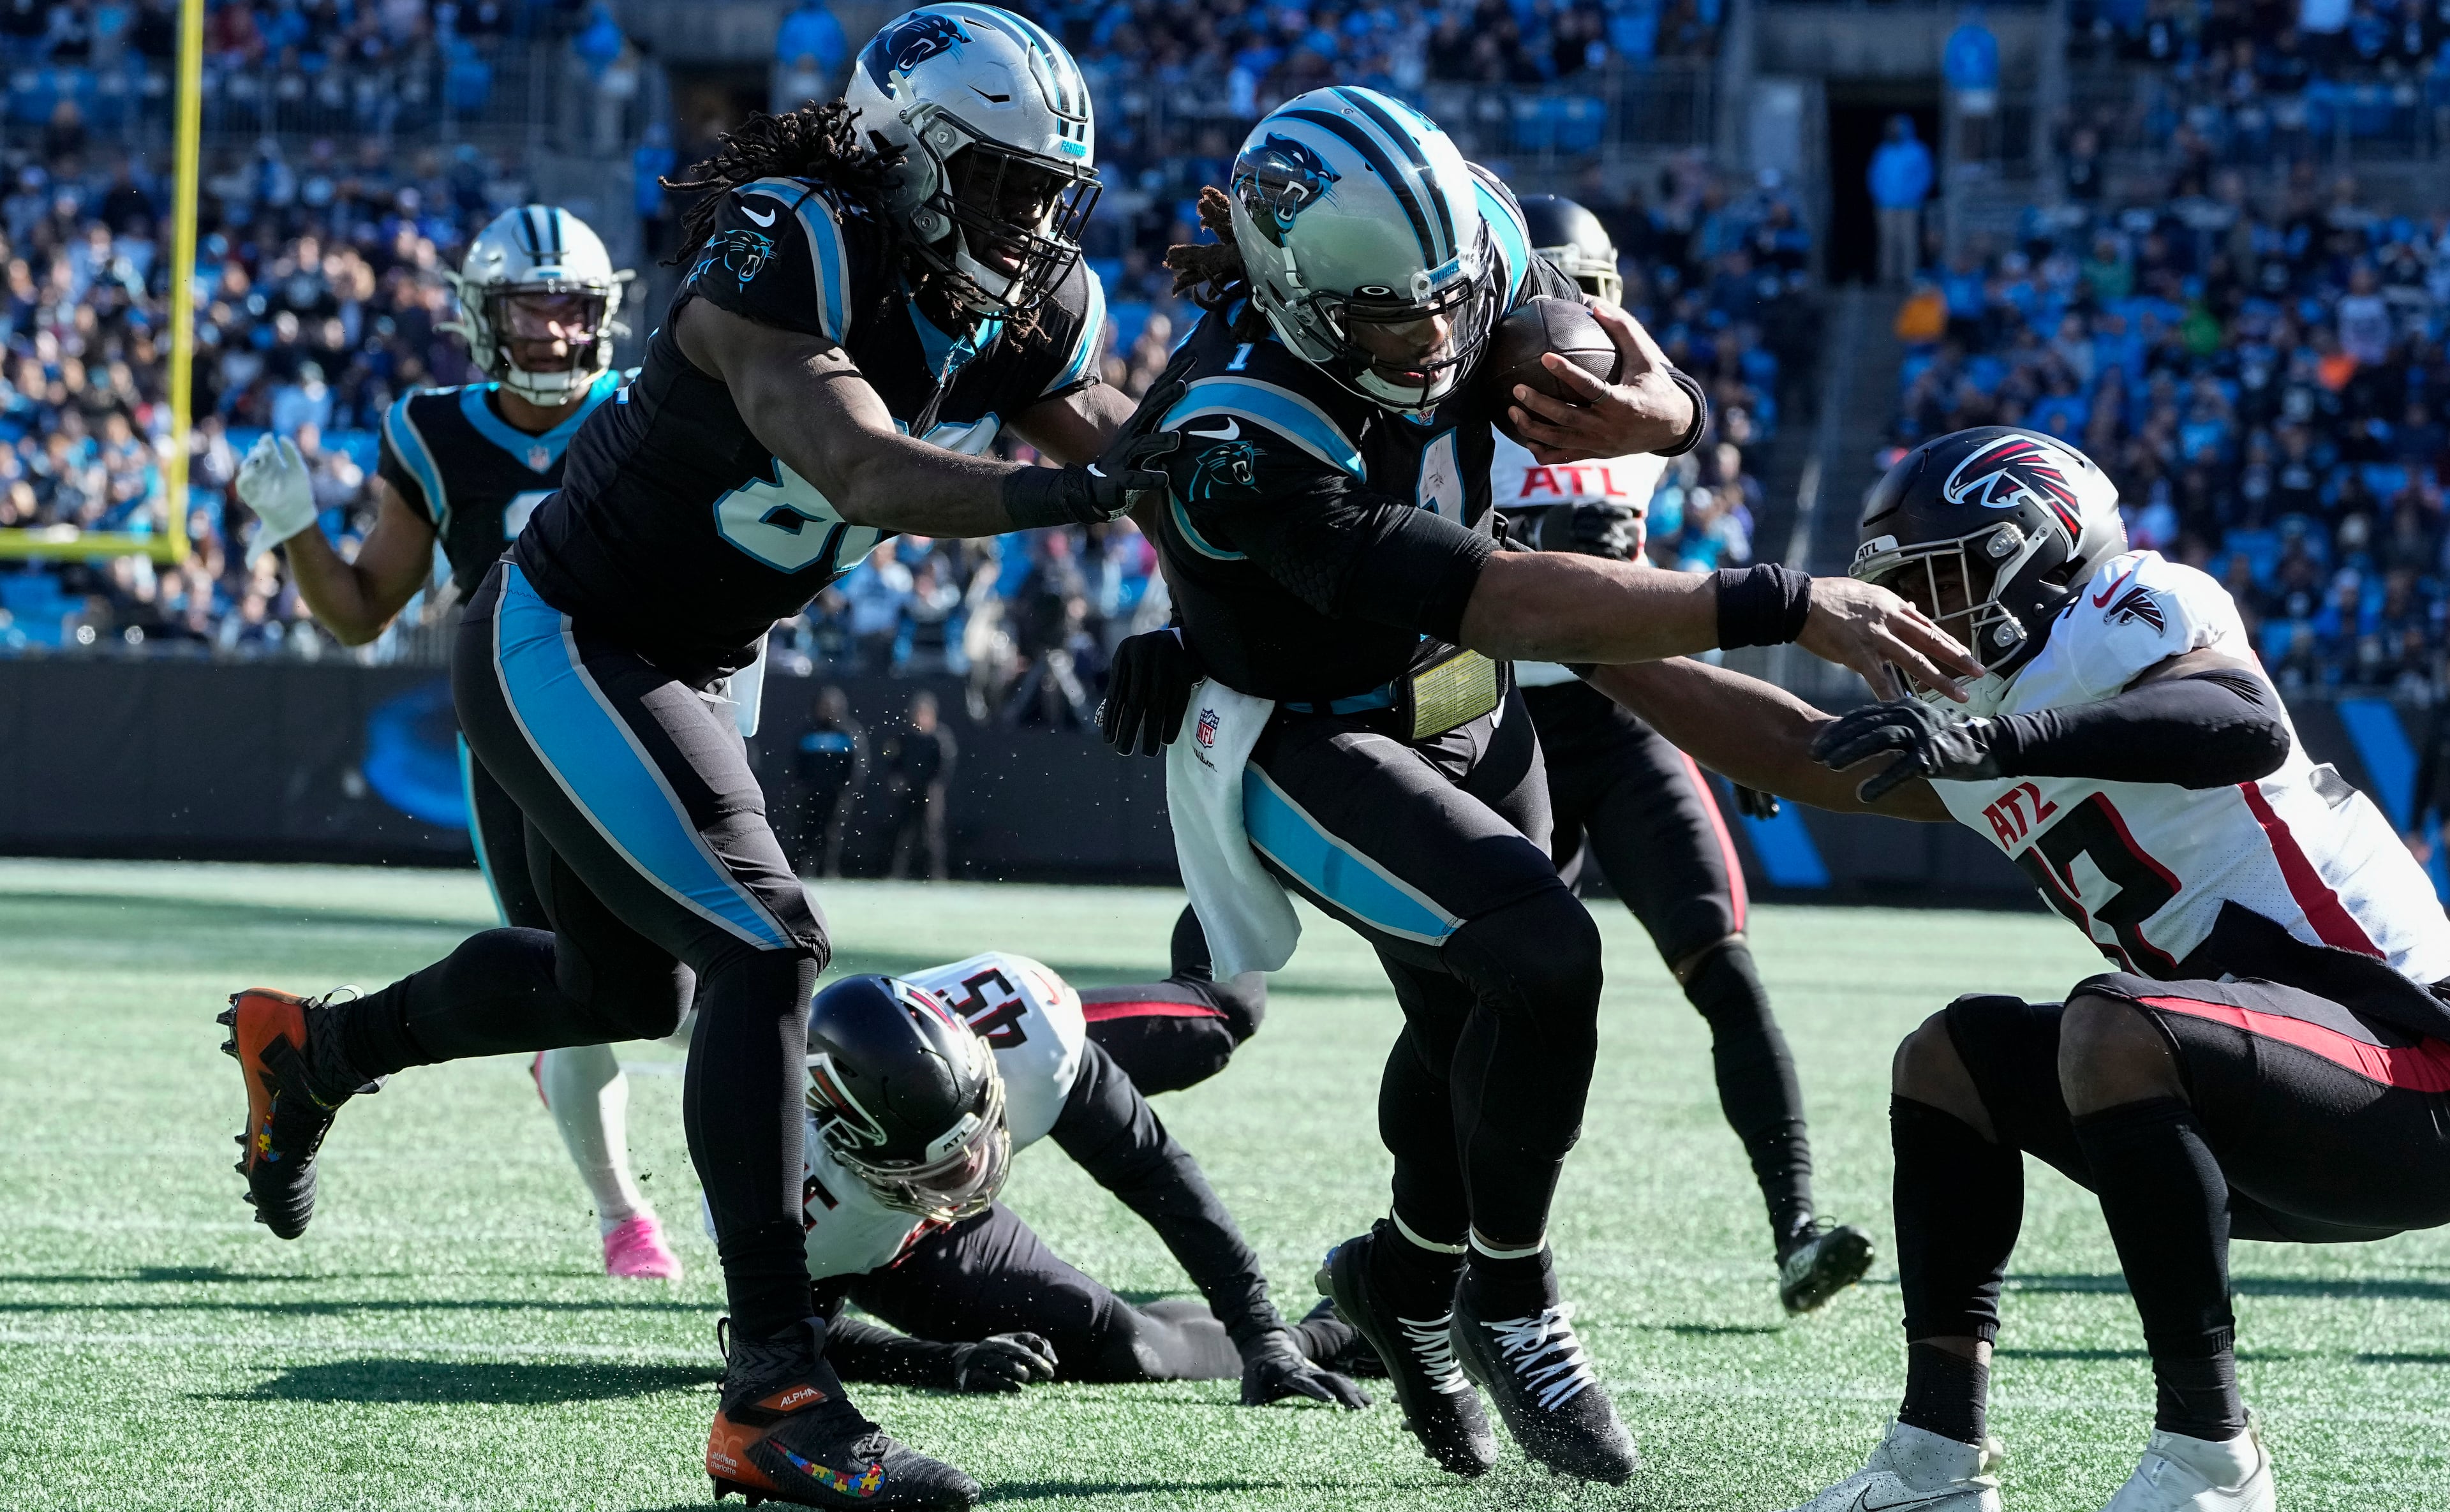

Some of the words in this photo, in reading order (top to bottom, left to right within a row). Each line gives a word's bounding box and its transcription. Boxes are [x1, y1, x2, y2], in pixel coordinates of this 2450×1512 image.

[1225, 342, 1255, 371] 1
[1519, 466, 1627, 498] ATL
[1859, 542, 1879, 560] ATL
[1198, 722, 1215, 745] NFL
[1982, 782, 2058, 851] ATL
[934, 967, 1028, 1050] 45
[943, 1130, 969, 1153] ATL
[780, 1388, 817, 1408] ALPHA
[710, 1460, 736, 1476] charlotte
[712, 1451, 737, 1467] autism
